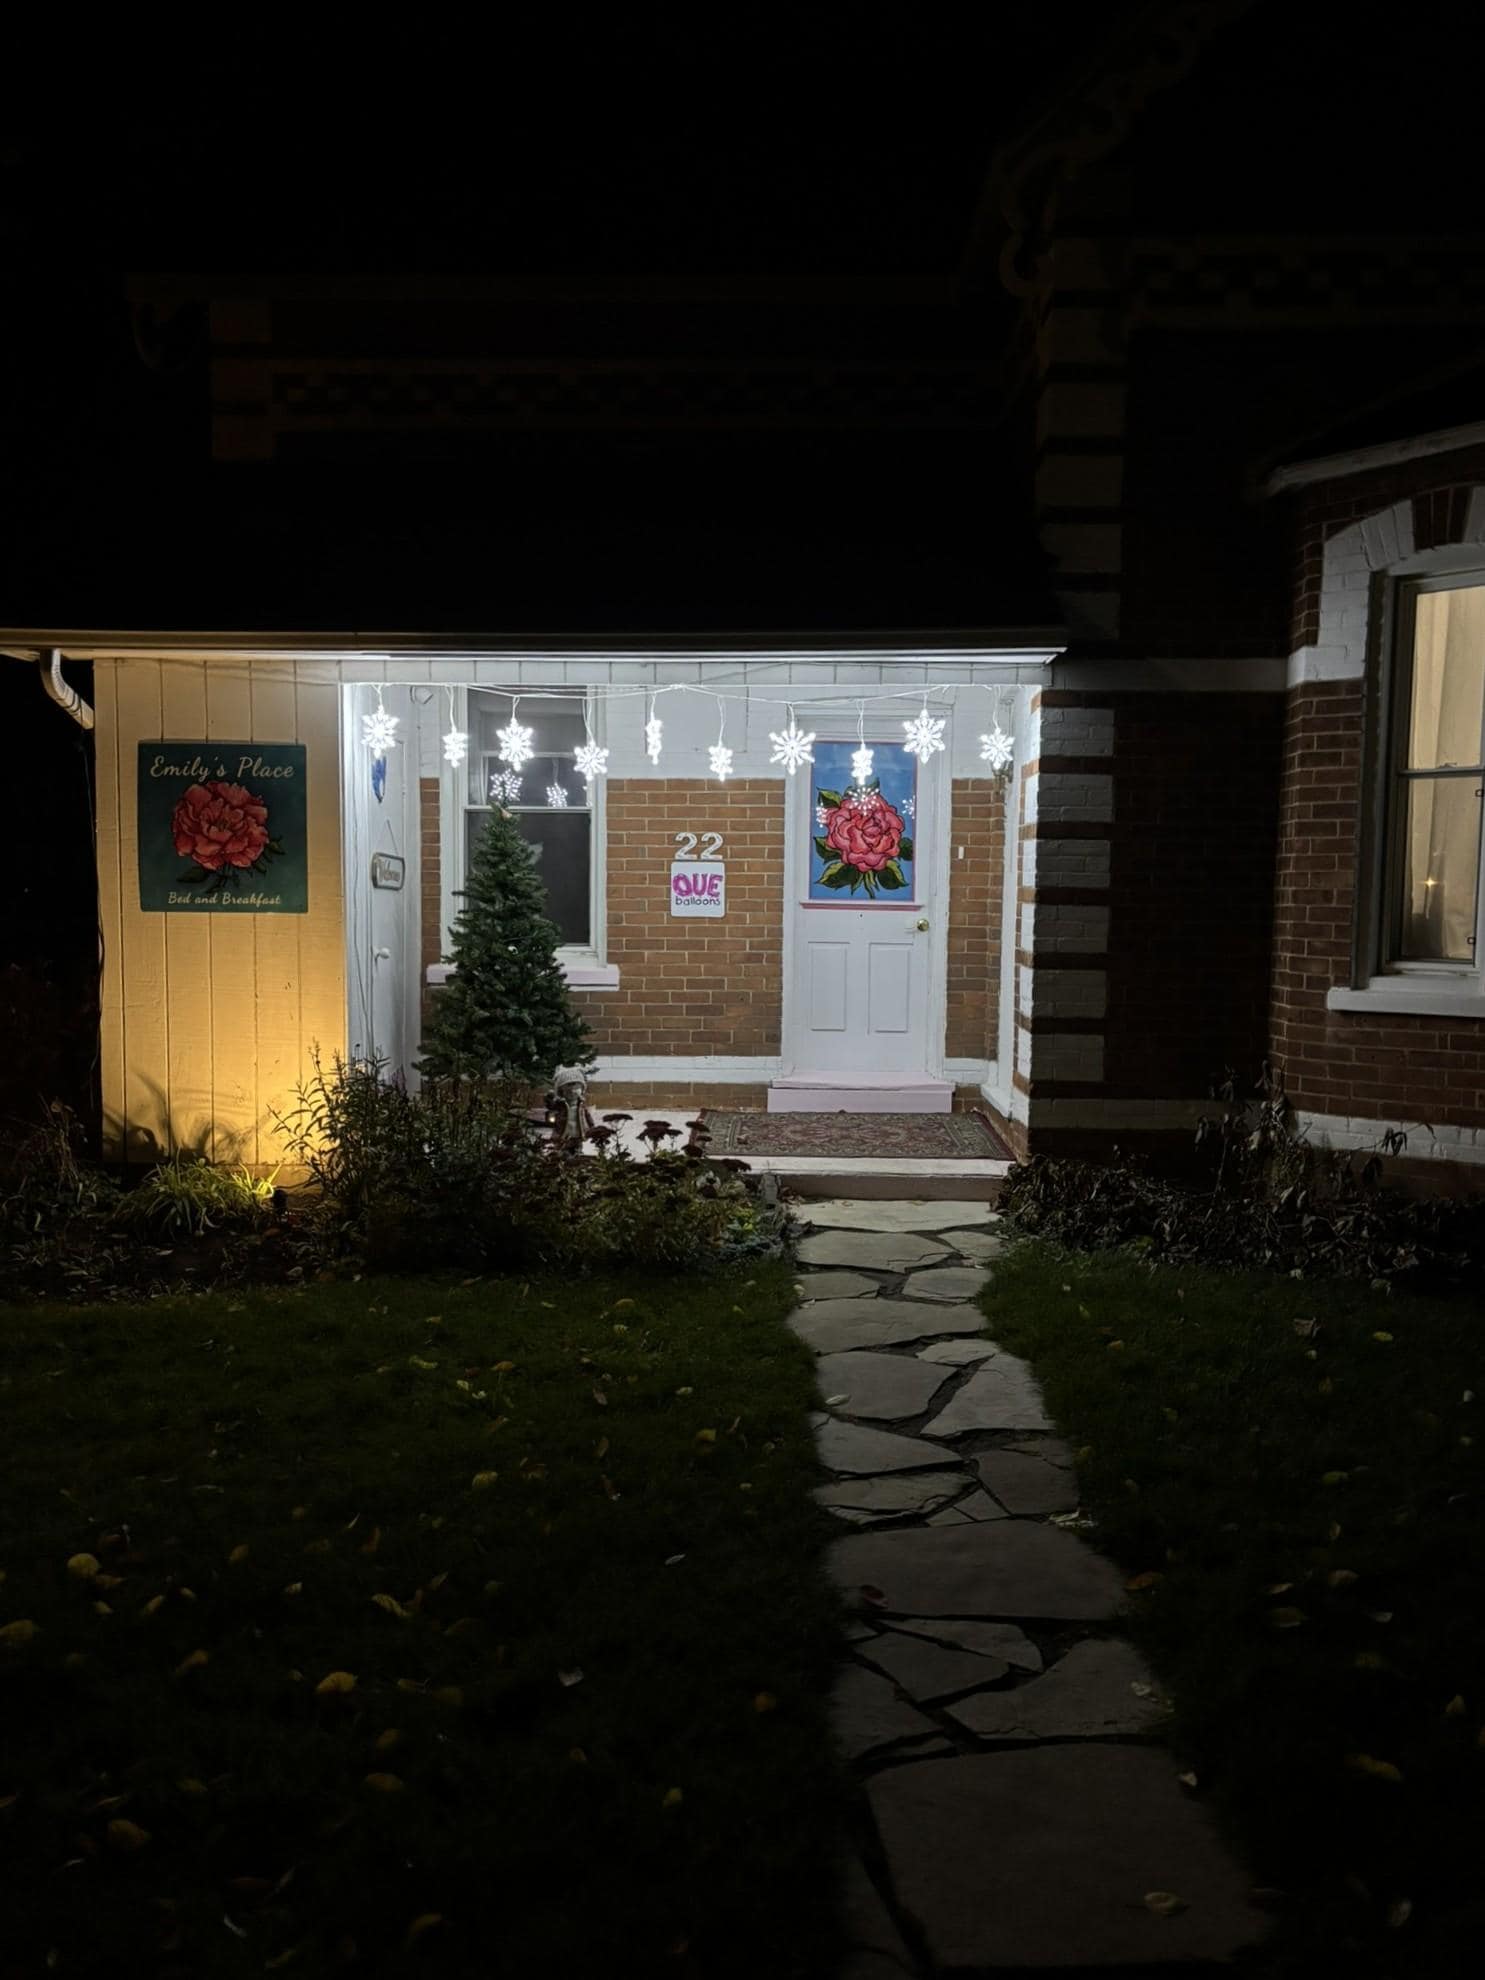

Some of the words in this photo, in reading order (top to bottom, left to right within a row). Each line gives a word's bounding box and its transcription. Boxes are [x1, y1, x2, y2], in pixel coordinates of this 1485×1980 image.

[150, 755, 227, 782] Emily's
[236, 756, 295, 779] Place
[675, 831, 724, 860] 22
[167, 891, 191, 905] Bed
[194, 892, 218, 905] and
[221, 892, 283, 908] Breakfast
[675, 896, 721, 906] balloons
